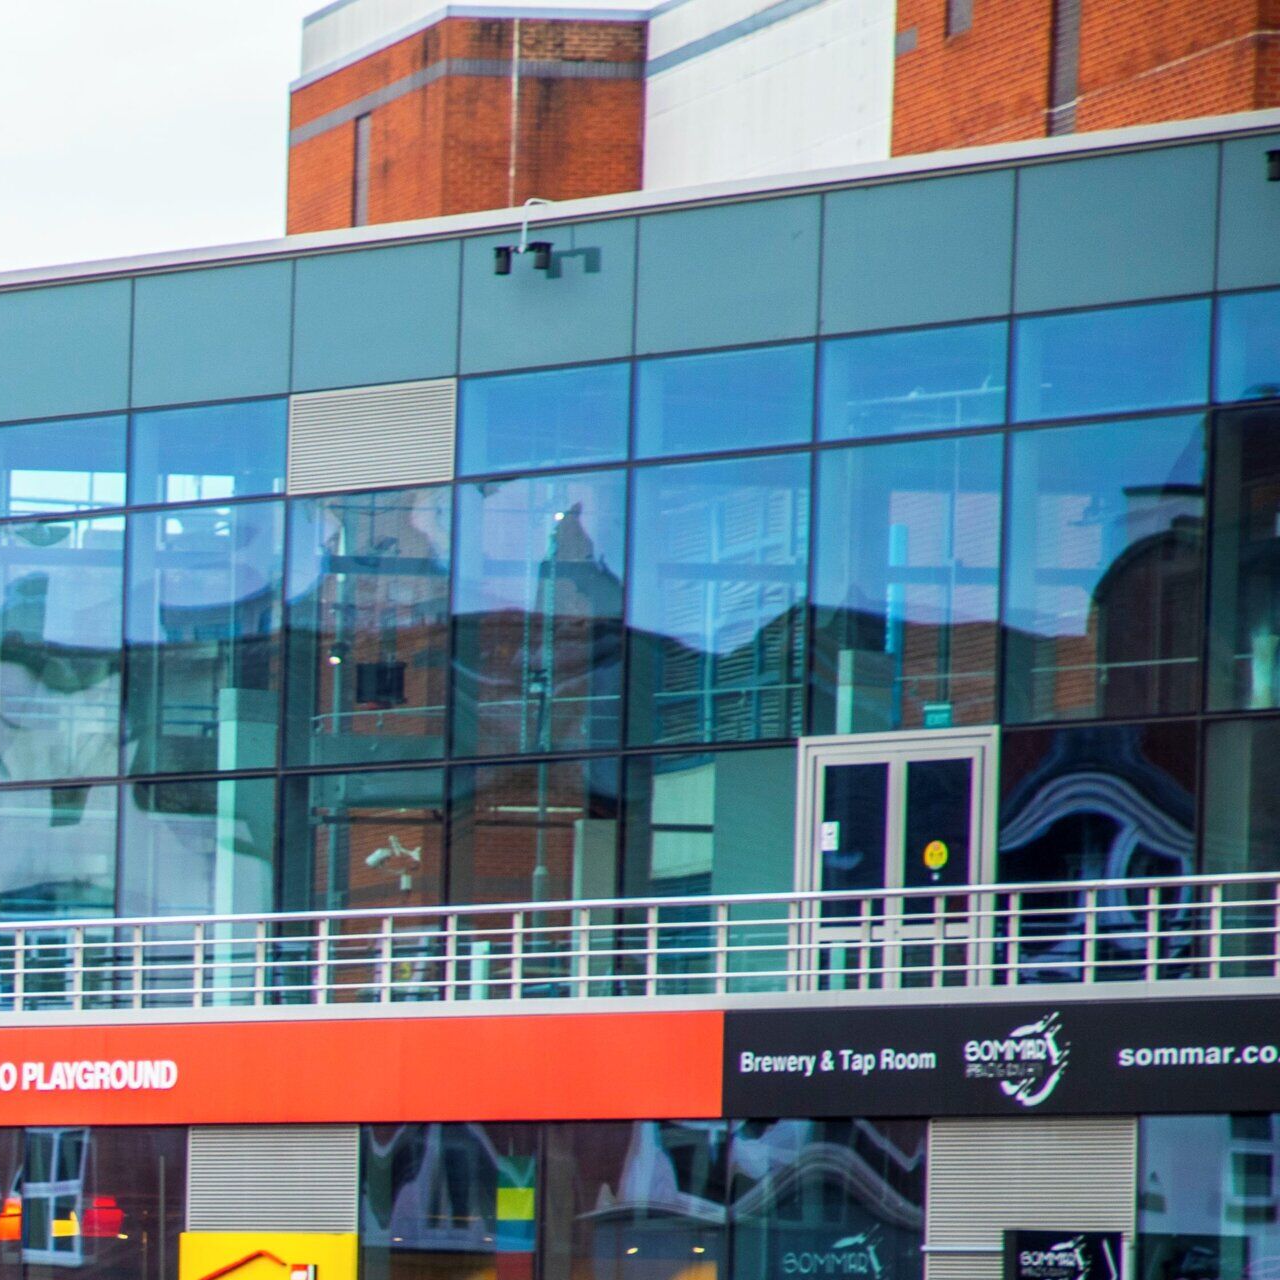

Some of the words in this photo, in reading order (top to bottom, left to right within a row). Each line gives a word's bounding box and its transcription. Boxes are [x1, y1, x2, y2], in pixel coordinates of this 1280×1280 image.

[740, 1051, 816, 1077] Brewery
[820, 1049, 835, 1072] &
[839, 1049, 876, 1075] Tap
[880, 1048, 936, 1070] Room
[964, 1038, 1047, 1062] SOMMAR
[1118, 1044, 1280, 1067] sommar.co
[21, 1059, 178, 1091] PLAYGROUND
